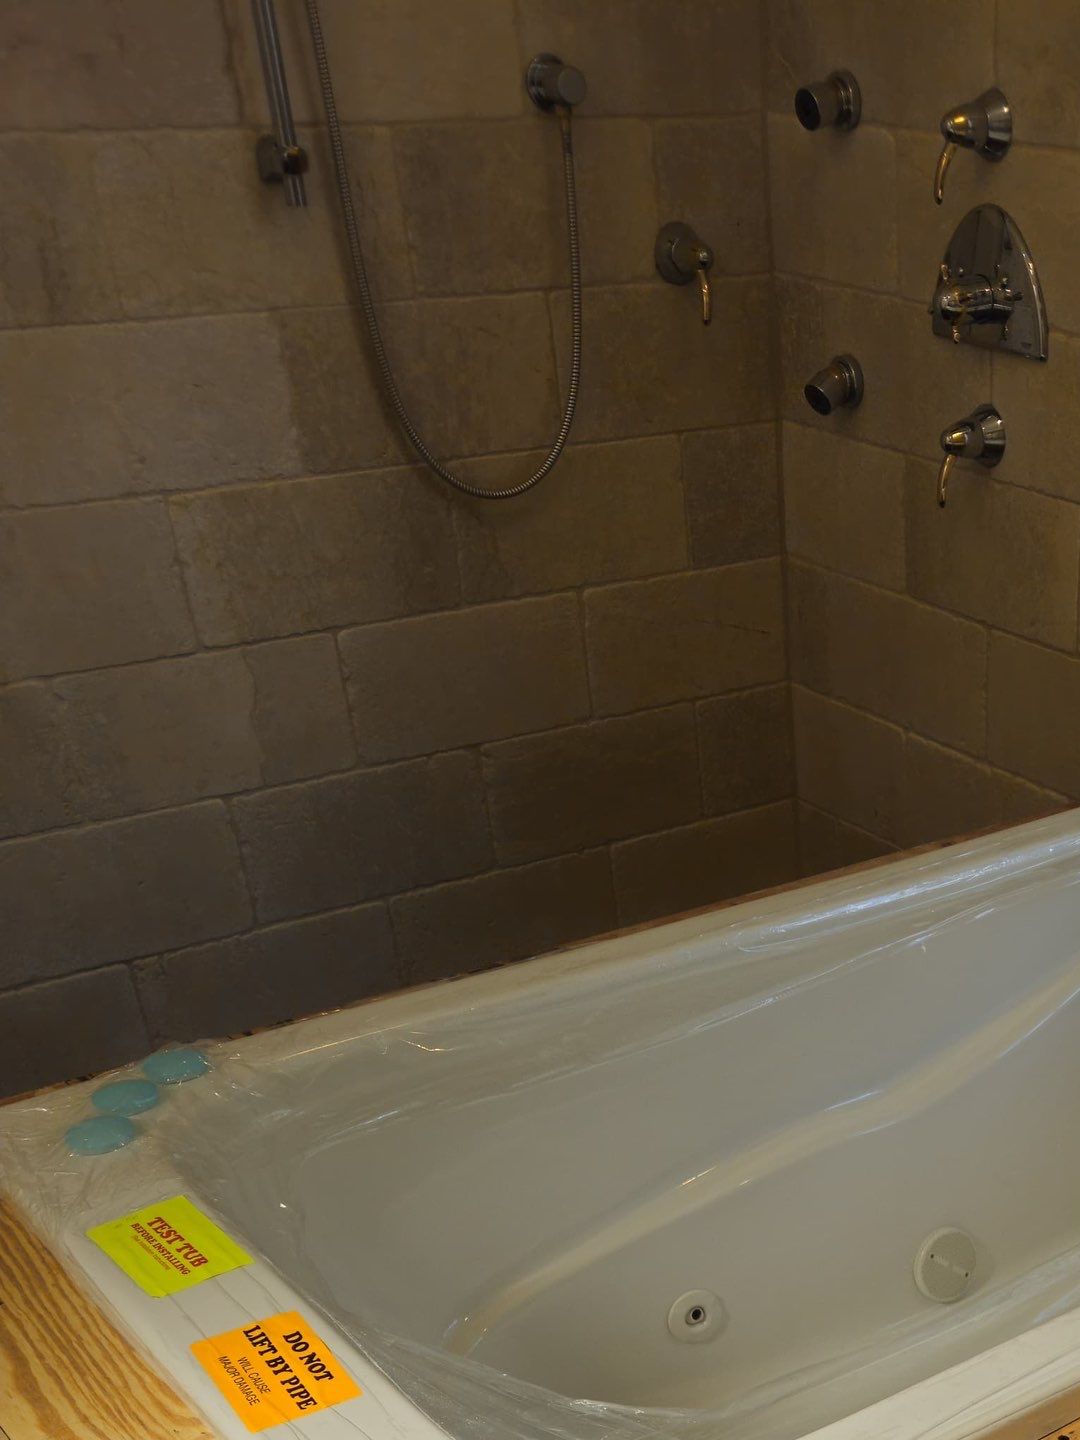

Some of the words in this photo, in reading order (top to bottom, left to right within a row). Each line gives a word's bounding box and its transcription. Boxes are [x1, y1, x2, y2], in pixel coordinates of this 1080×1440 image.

[130, 1222, 158, 1248] BEFORE
[152, 1242, 191, 1275] INSTALLING
[147, 1216, 185, 1245] TEST
[175, 1243, 209, 1267] TUB
[217, 1355, 240, 1379] MAJOR
[233, 1375, 260, 1407] DAMAGE
[237, 1356, 252, 1373] WILL
[249, 1372, 271, 1395] CAUSE
[243, 1325, 278, 1356] LIFT
[265, 1355, 294, 1376] BY
[280, 1375, 318, 1410] PIPE
[282, 1330, 310, 1352] DO
[299, 1352, 335, 1381] NOT
